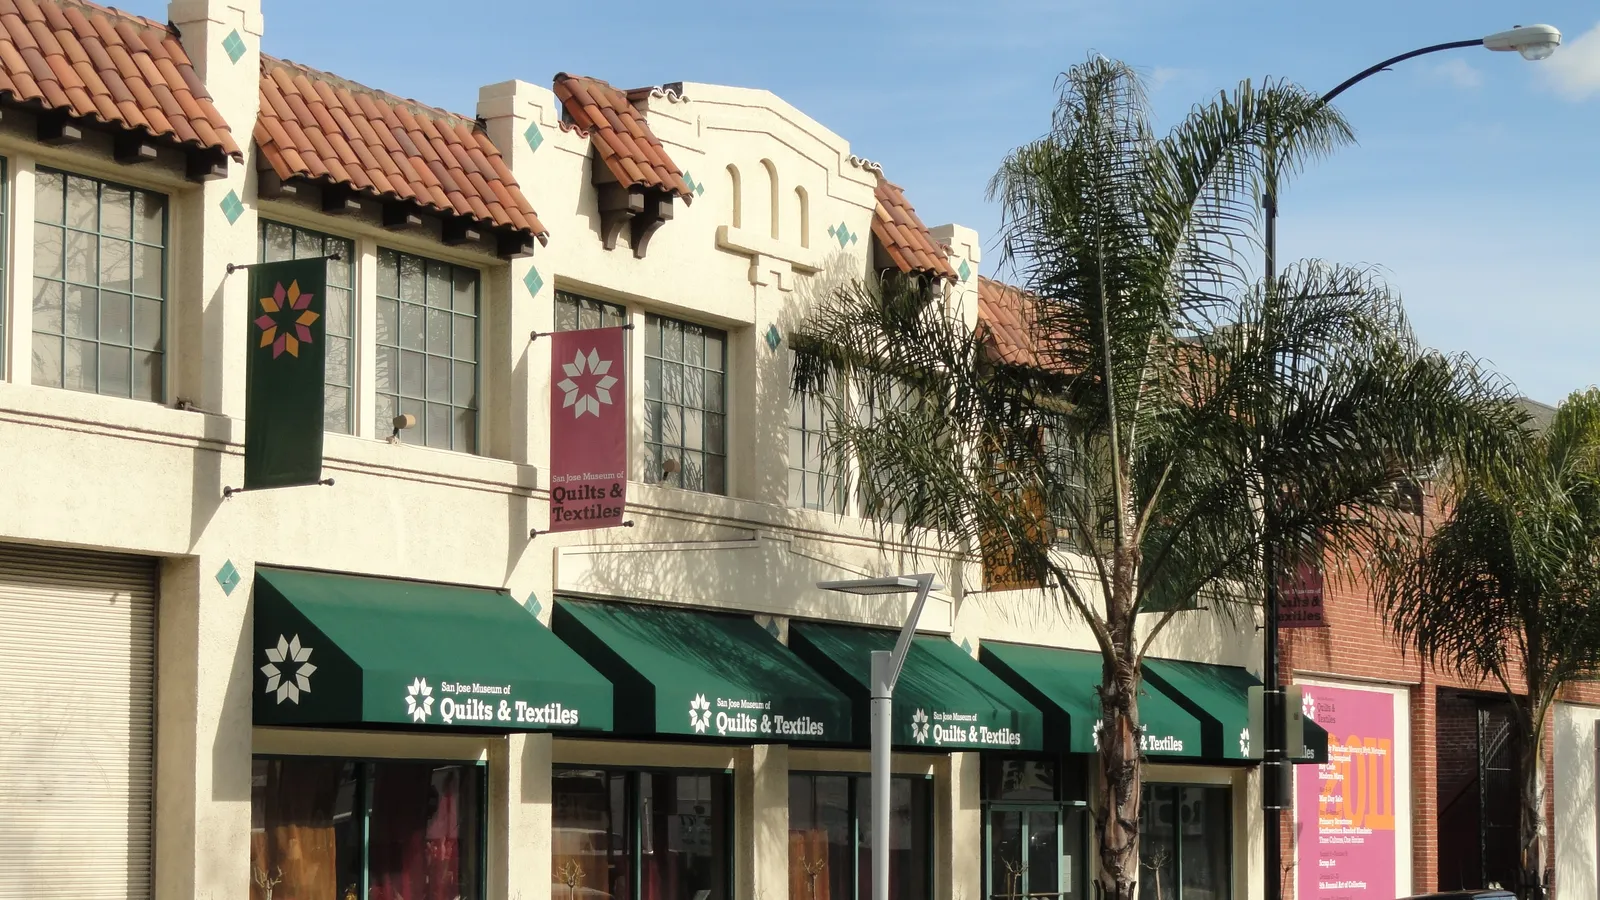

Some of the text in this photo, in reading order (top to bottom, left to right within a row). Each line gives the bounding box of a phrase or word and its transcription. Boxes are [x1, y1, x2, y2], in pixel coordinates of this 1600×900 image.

[566, 474, 581, 483] Jose
[583, 472, 615, 480] Museum
[552, 483, 623, 504] Quilts &
[552, 504, 621, 522] Textiles
[1279, 611, 1321, 621] extiles
[441, 682, 511, 695] San Jose Museum of
[440, 697, 579, 724] Quilts & Textiles
[716, 698, 771, 710] San Jose Museum of
[716, 712, 824, 735] Quilts & Textiles
[933, 711, 977, 722] San Jose Museum of
[933, 724, 1021, 745] Quilts & Textiles
[1140, 735, 1183, 751] & Textiles
[1318, 732, 1395, 830] 2011
